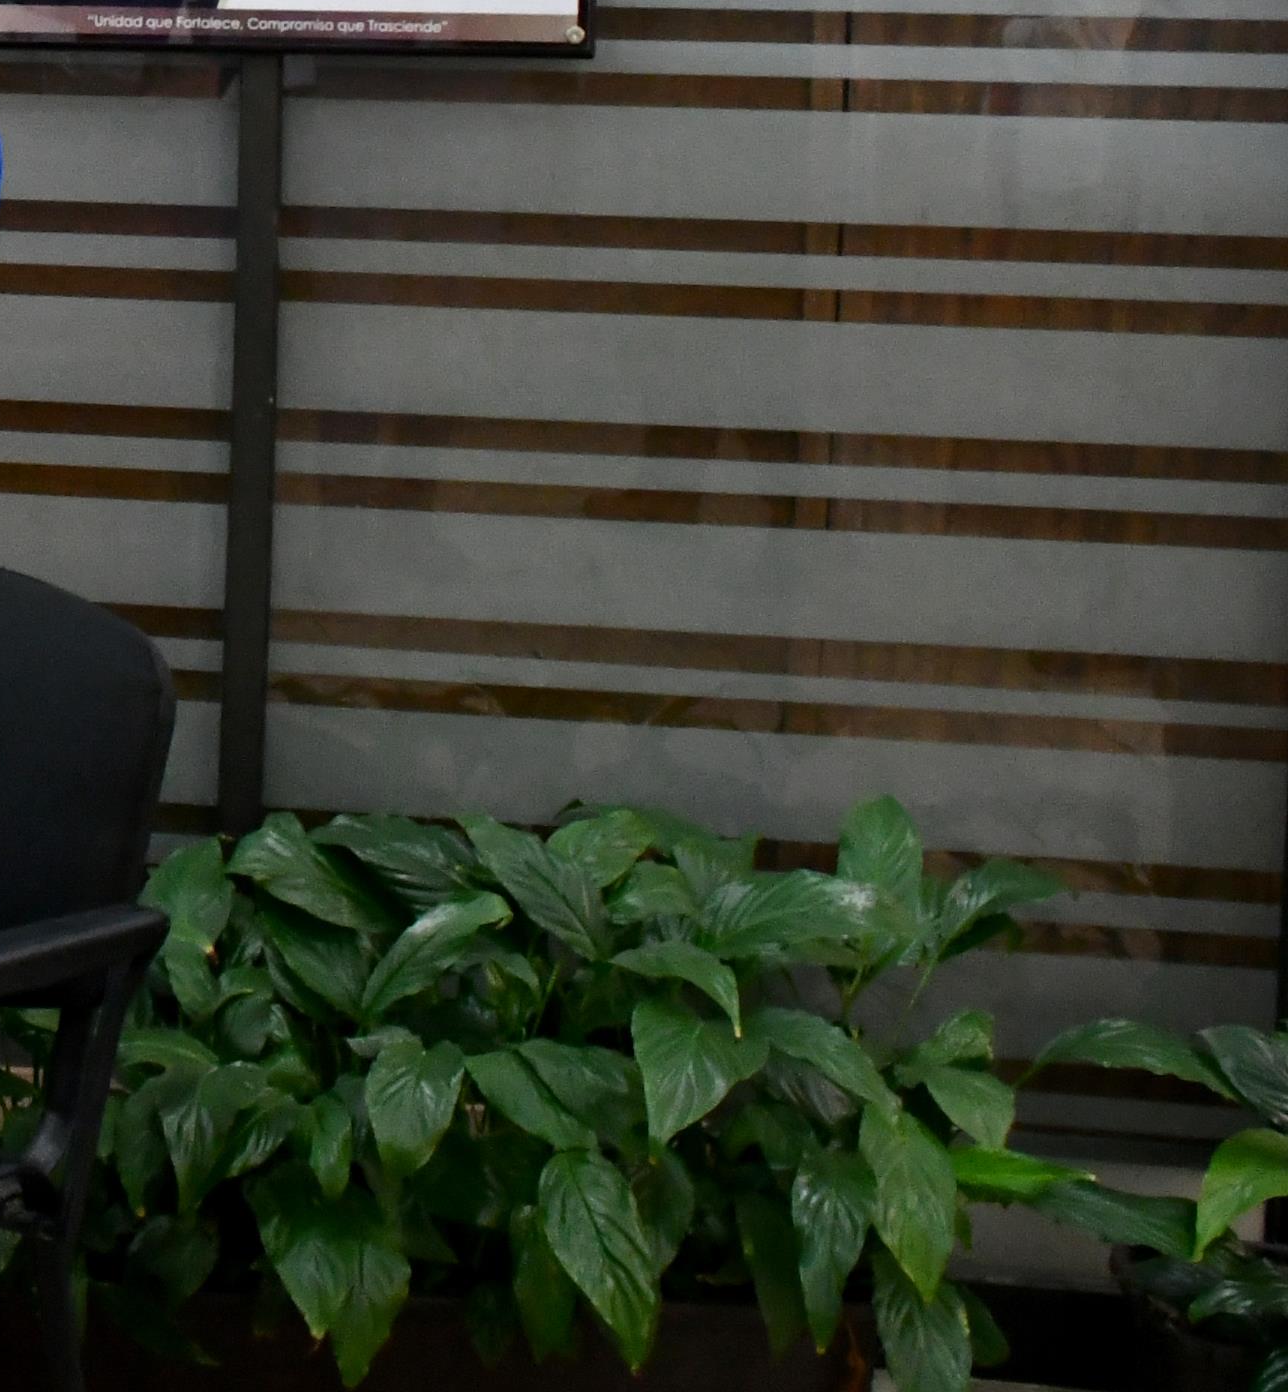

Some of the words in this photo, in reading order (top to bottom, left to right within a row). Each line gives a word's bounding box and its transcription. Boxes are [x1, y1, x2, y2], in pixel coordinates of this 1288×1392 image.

[146, 17, 173, 30] que
[176, 16, 244, 31] Fortalece,
[247, 17, 334, 33] Compromiso
[337, 20, 364, 34] que
